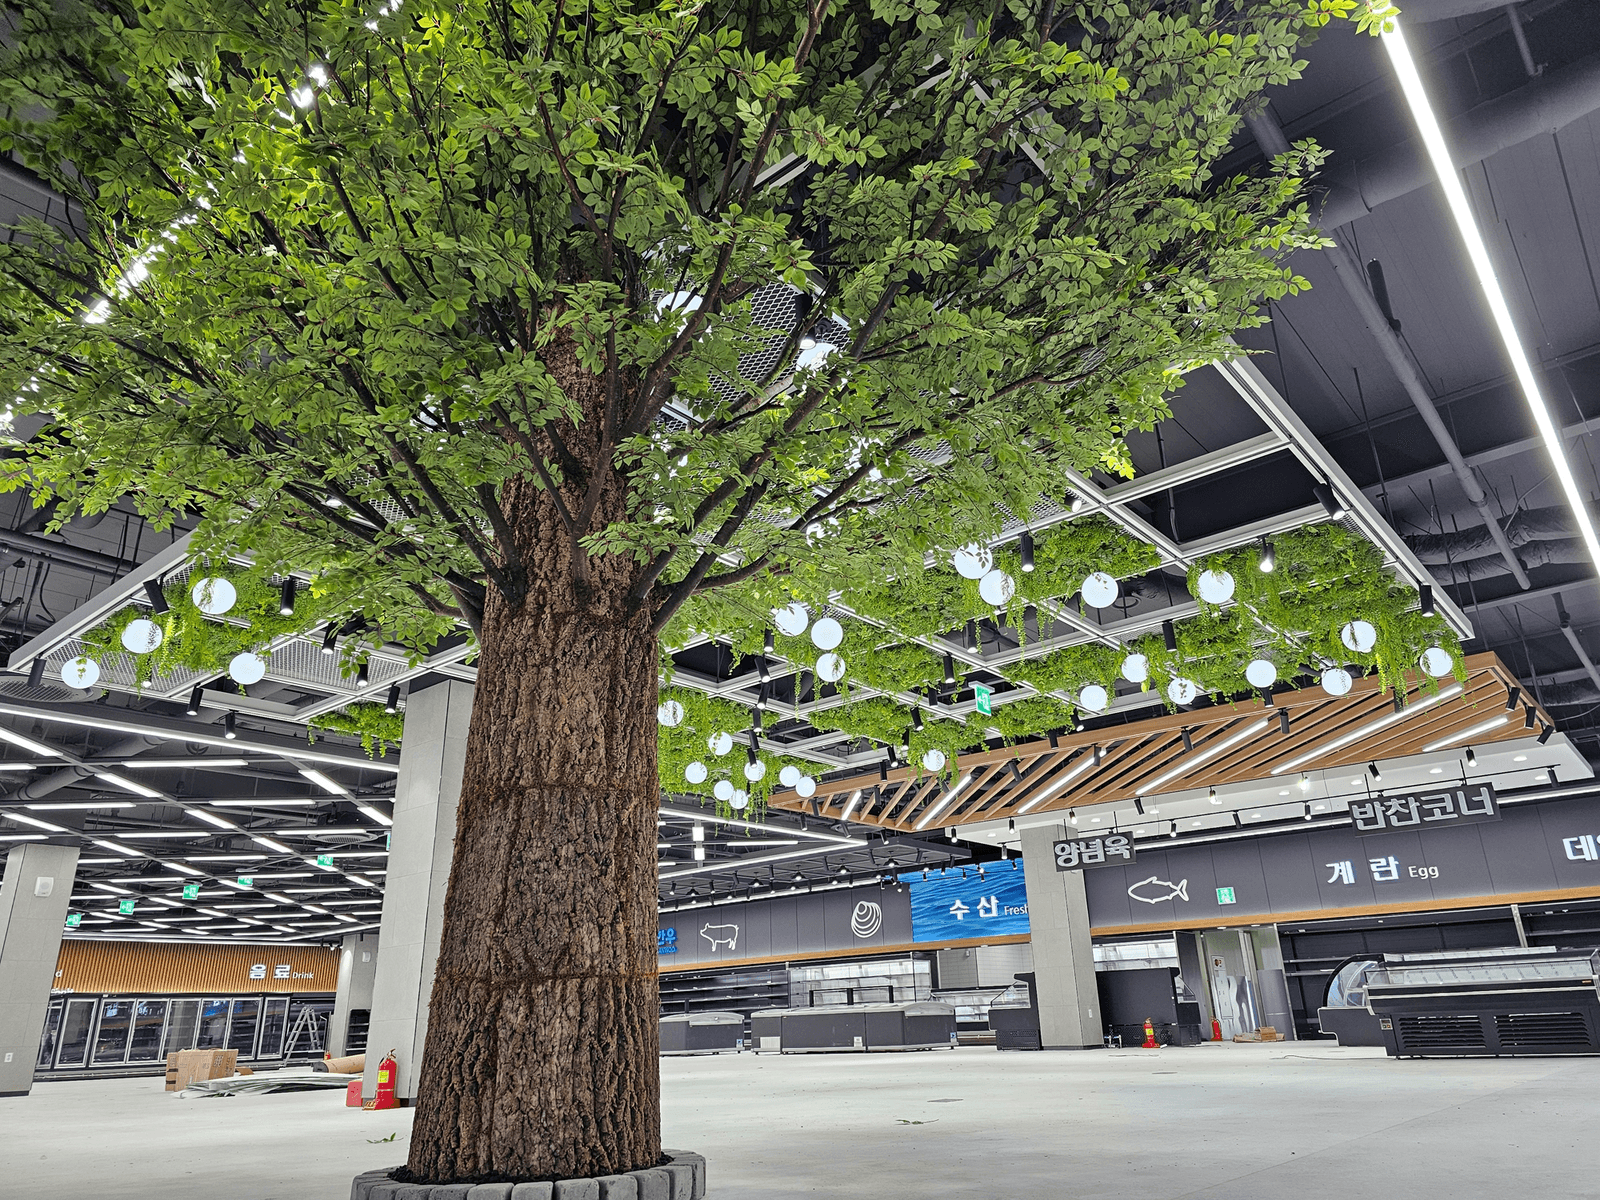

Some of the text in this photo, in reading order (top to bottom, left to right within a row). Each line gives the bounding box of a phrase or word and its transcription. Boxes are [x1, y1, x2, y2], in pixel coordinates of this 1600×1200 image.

[1351, 786, 1495, 831] 반찬코너
[1054, 835, 1131, 868] 양념육
[1562, 834, 1600, 861] 데
[1408, 865, 1440, 880] Egg
[292, 970, 314, 980] Drink
